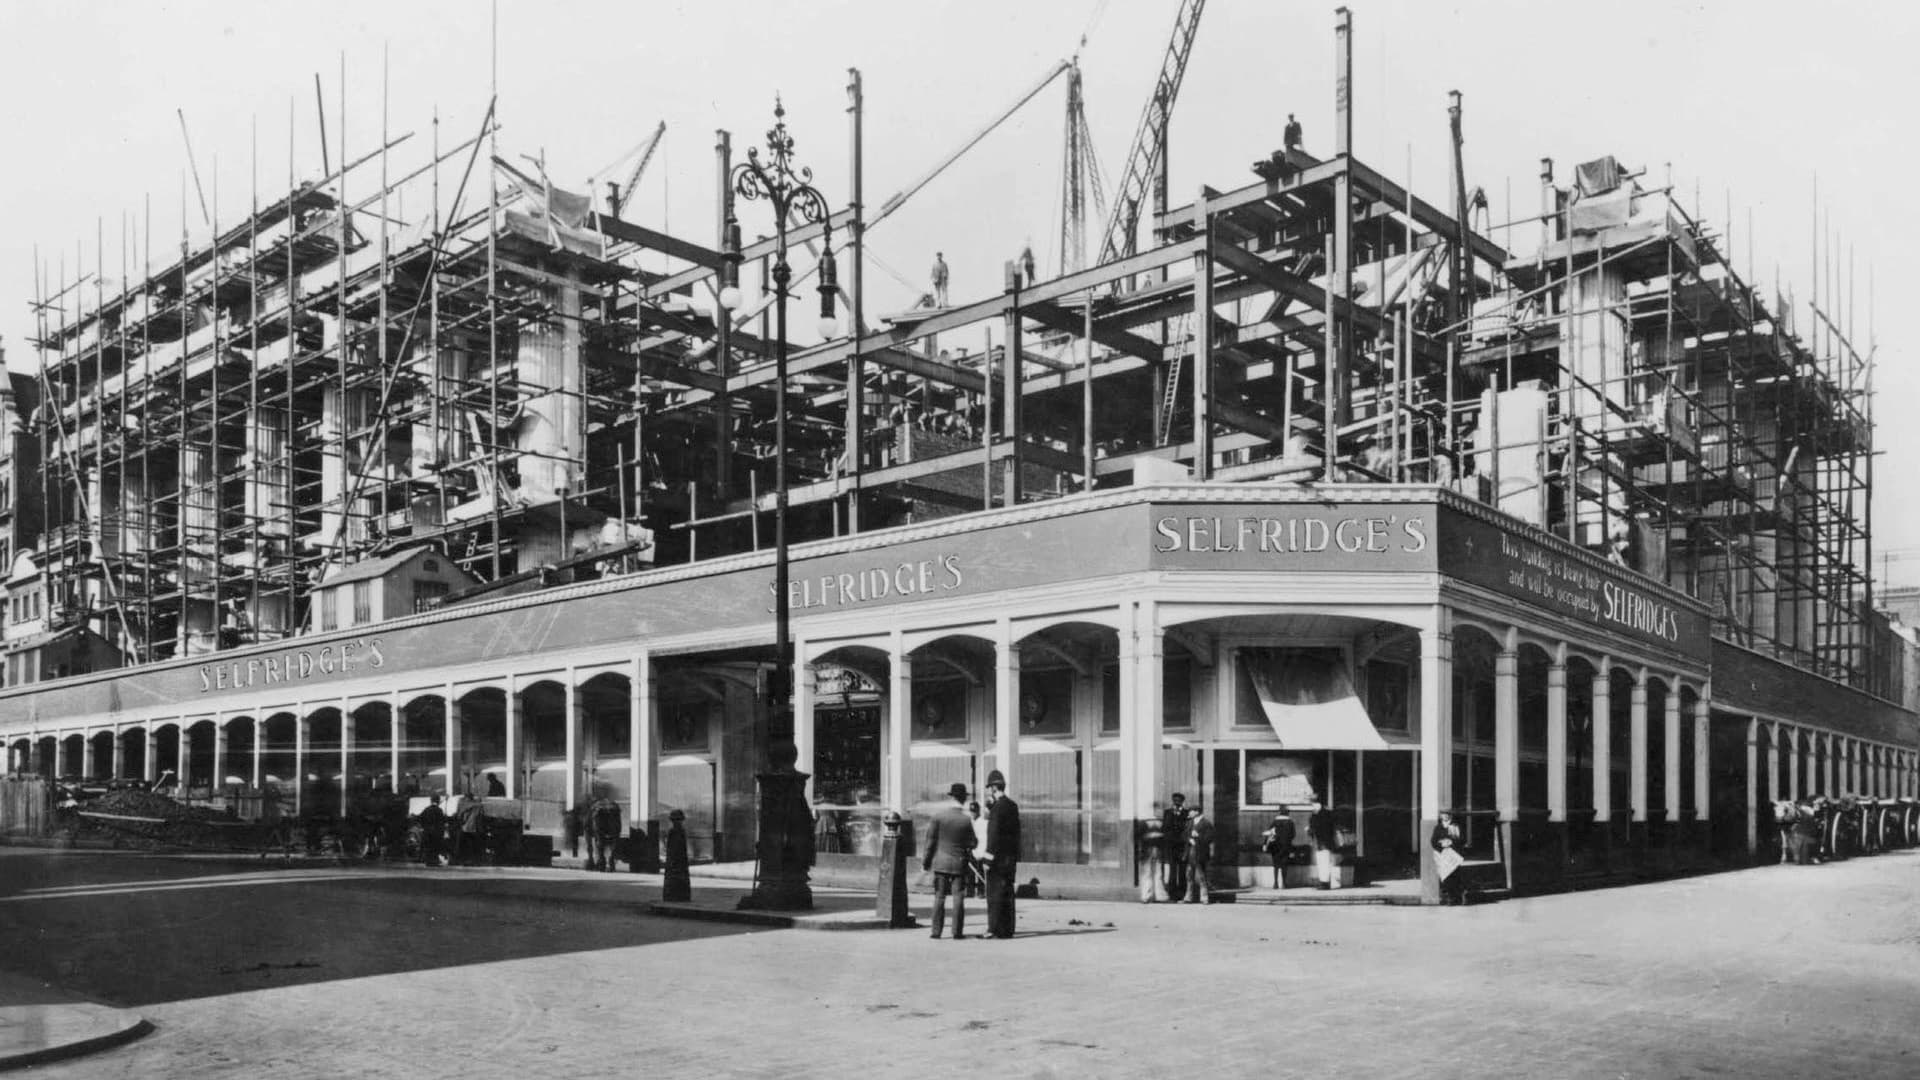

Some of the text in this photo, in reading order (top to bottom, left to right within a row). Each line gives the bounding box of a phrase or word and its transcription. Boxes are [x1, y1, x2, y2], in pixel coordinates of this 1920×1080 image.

[1155, 514, 1427, 553] SELFRIDGE'S
[767, 553, 963, 613] SELFRIDGE'S
[1508, 568, 1524, 588] and
[1528, 574, 1542, 595] will
[1543, 576, 1555, 599] be
[1556, 587, 1590, 617] occupied
[1590, 592, 1601, 623] by
[200, 638, 384, 692] SELFRIDGE'S
